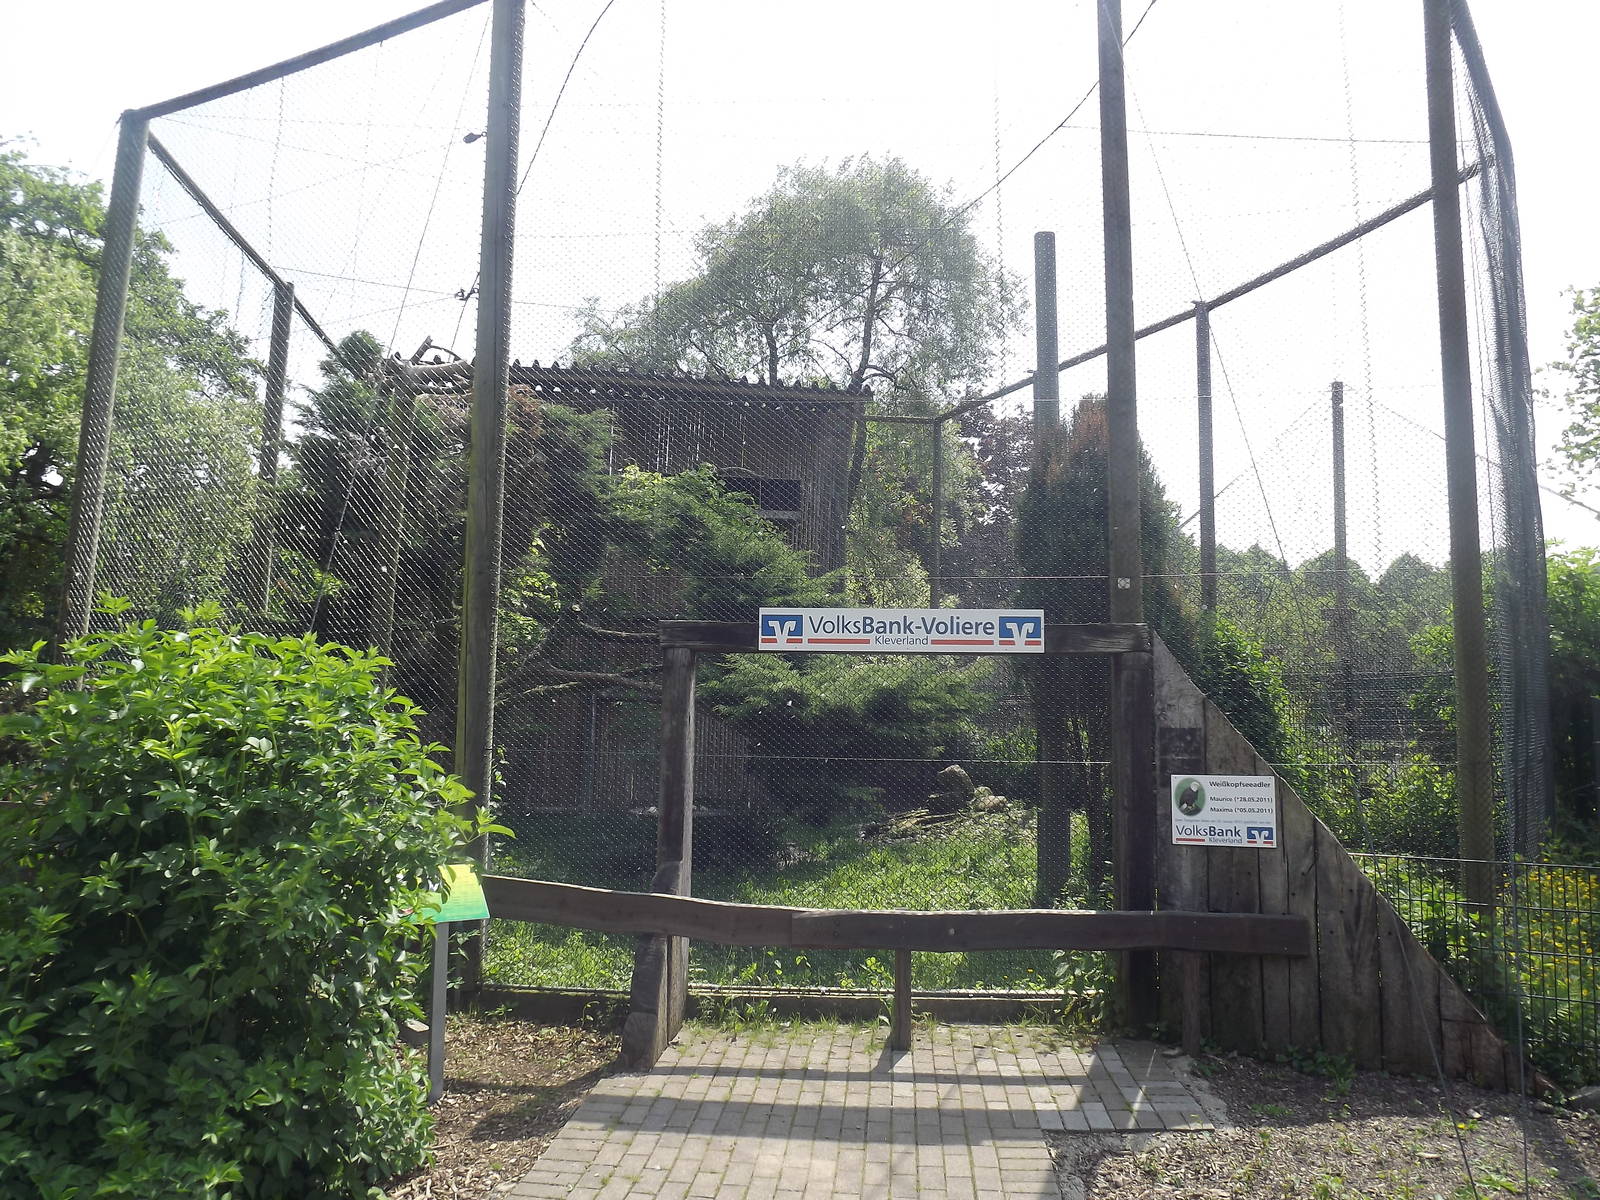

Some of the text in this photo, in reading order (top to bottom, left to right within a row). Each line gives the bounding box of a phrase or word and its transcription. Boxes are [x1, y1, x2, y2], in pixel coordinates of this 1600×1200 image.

[808, 615, 995, 636] VolksBank-Voliere
[874, 635, 929, 646] Kleverland
[1209, 781, 1271, 789] Weißkopfseeadler
[1175, 825, 1242, 837] VolksBank
